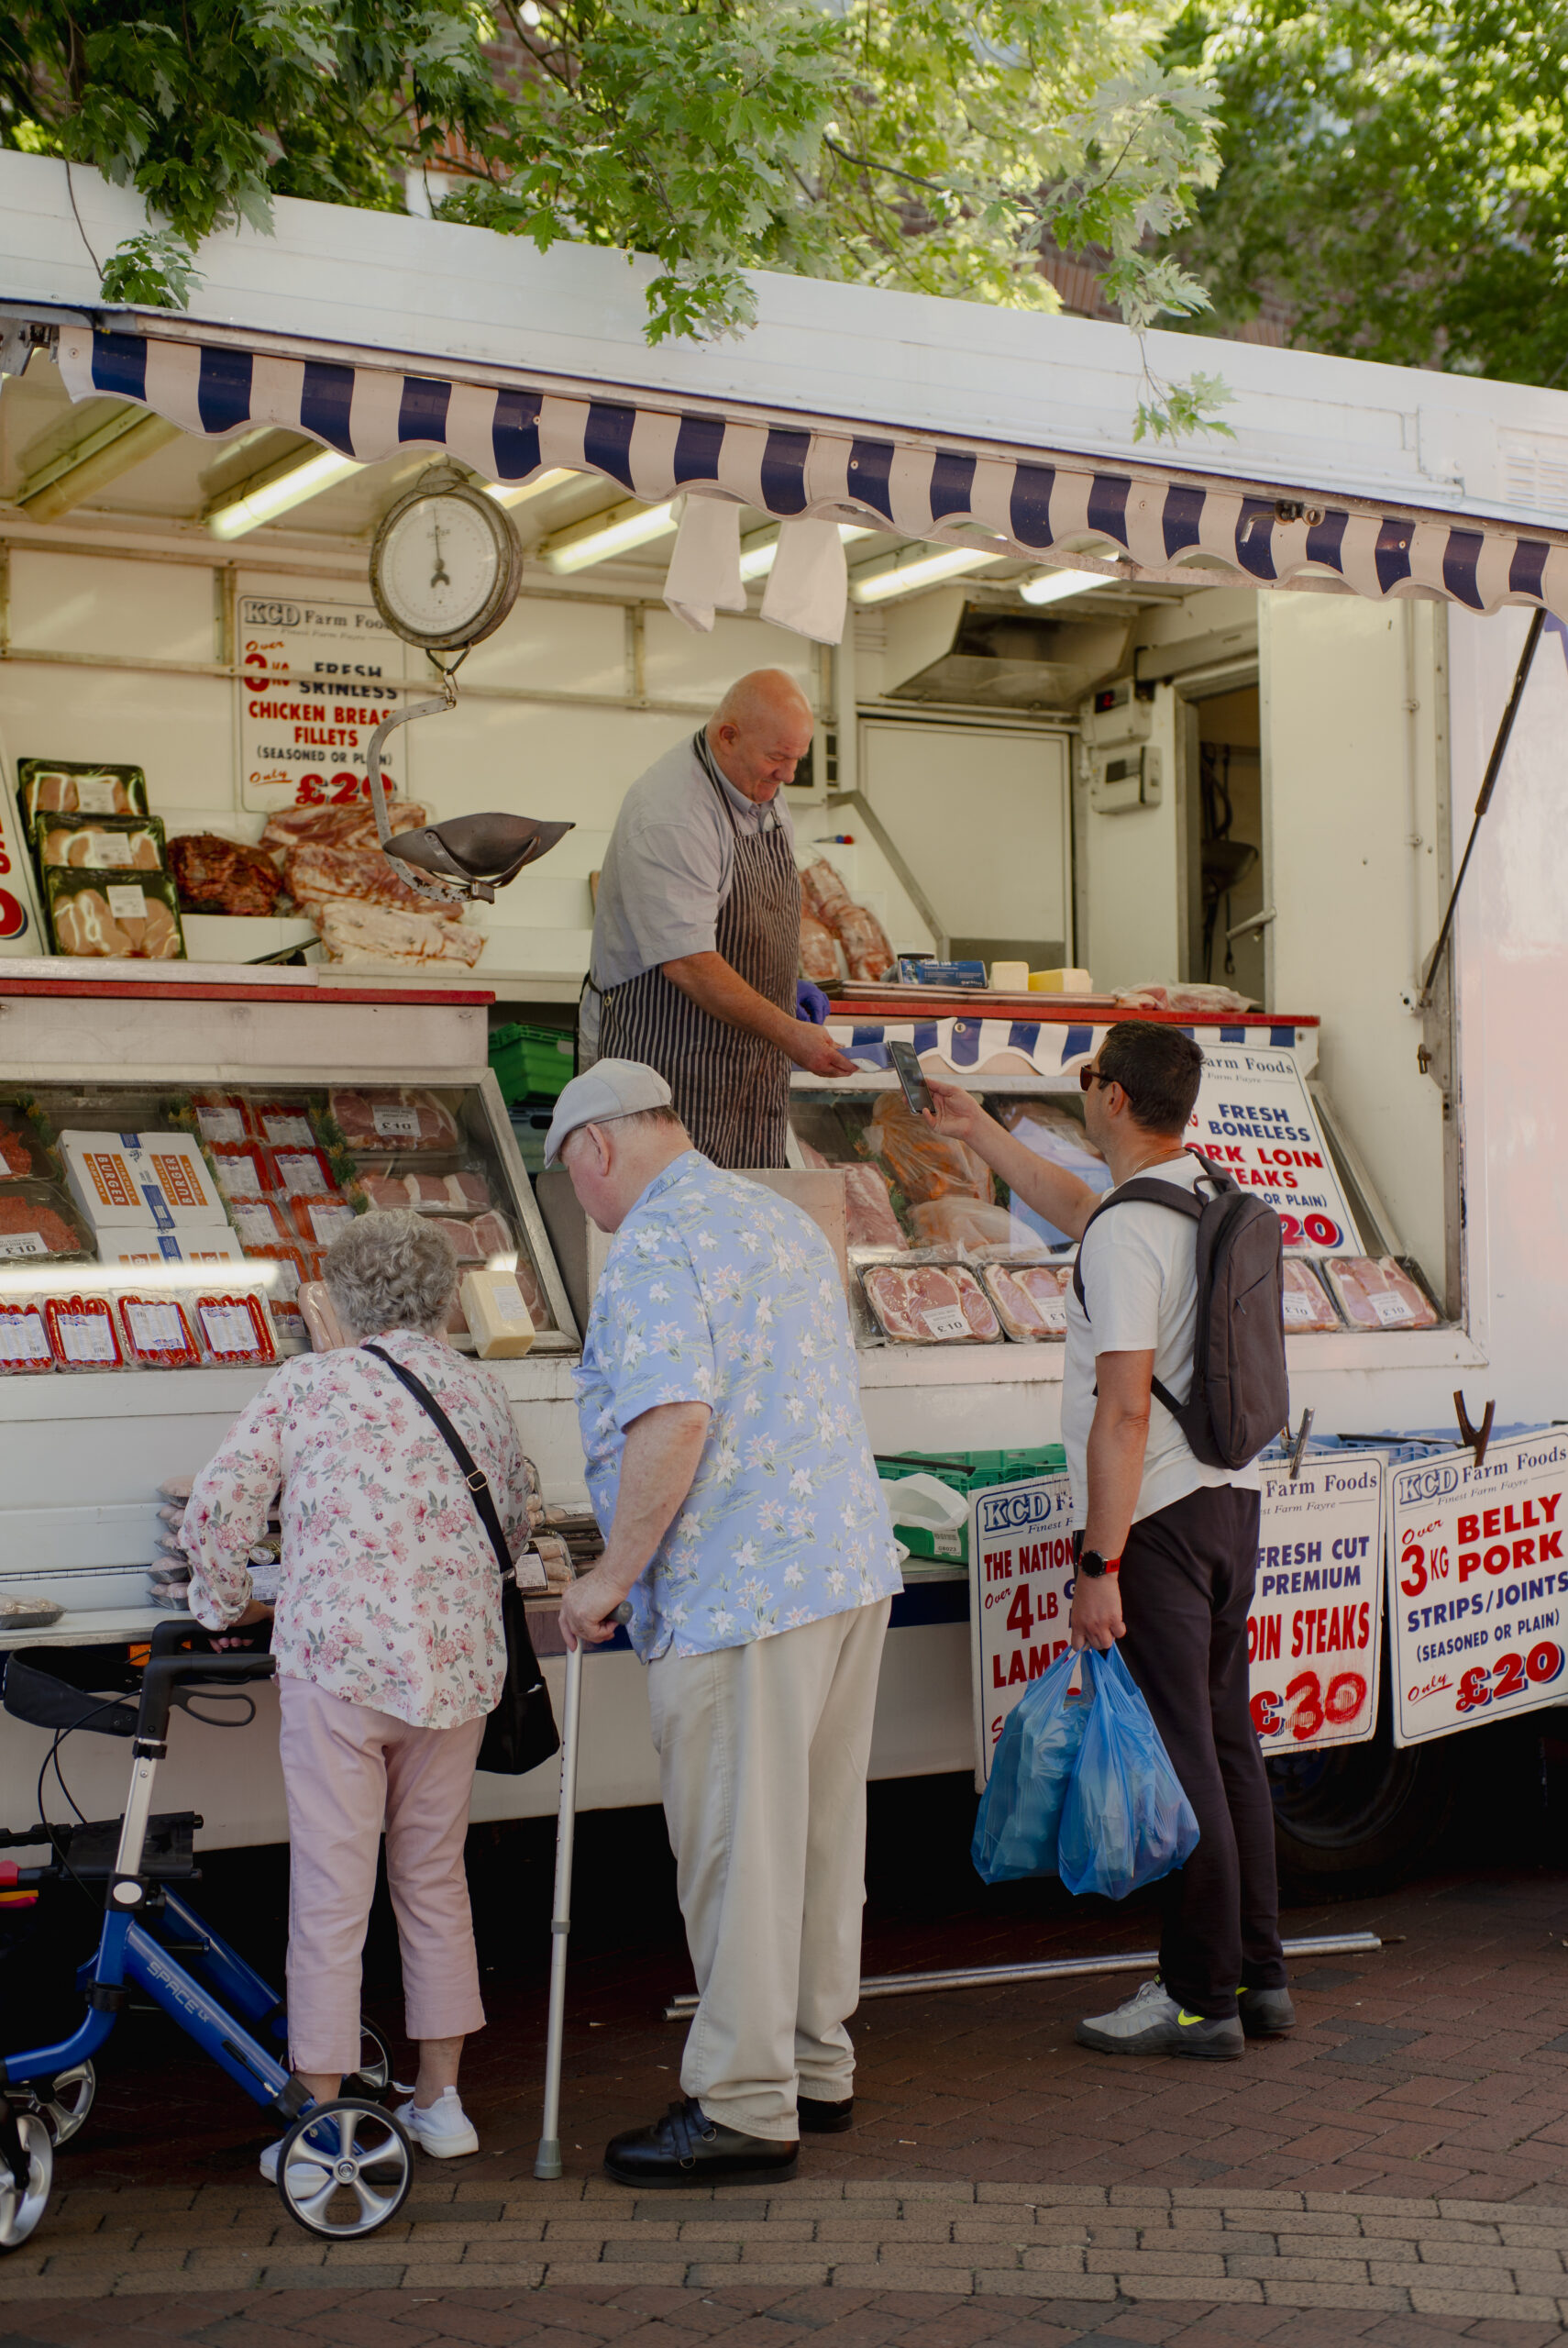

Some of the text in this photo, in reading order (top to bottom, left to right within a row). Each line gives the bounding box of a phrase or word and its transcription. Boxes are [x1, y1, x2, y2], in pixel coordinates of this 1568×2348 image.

[244, 601, 392, 629] KCD Farm Foo
[246, 640, 285, 652] Over
[315, 661, 381, 678] FRESH
[299, 681, 397, 700] SKINLESS
[248, 701, 394, 726] CHICKEN BREAS
[294, 726, 359, 748] FILLETS
[257, 745, 392, 766] (SEASONED OR PLN)
[249, 769, 287, 784] Only
[1201, 1057, 1294, 1074] arm Foods
[1207, 1072, 1232, 1081] Farm
[1235, 1074, 1262, 1084] Fayre
[1218, 1103, 1290, 1123] FRESH
[1208, 1121, 1311, 1142] BONELESS
[1185, 1142, 1324, 1168] ORK LOIN
[97, 1157, 126, 1202] BURGER
[165, 1157, 193, 1203] BURGER
[1223, 1168, 1298, 1189] TEAKS
[1264, 1192, 1282, 1204] OR
[1286, 1194, 1328, 1208] PLAIN)
[1279, 1213, 1344, 1248] 20
[1050, 1312, 1066, 1321] £1
[1285, 1306, 1309, 1315] £10
[1383, 1306, 1405, 1316] £10
[937, 1321, 963, 1333] £10
[1265, 1471, 1377, 1498] Farm Foods
[1399, 1446, 1567, 1505] KCD Farm Foods
[1437, 1479, 1529, 1506] Finest Farm Fayre
[983, 1492, 1051, 1533] KCD
[1275, 1504, 1302, 1514] Farm
[1307, 1501, 1336, 1512] Fayre
[1401, 1492, 1562, 1545] Over BELLY
[1028, 1521, 1062, 1534] Finest
[984, 1536, 1075, 1582] THE NATION
[1256, 1535, 1370, 1569] FRESH CUT
[1400, 1530, 1564, 1598] 3 KG PORK
[1262, 1565, 1361, 1597] PREMIUM
[984, 1587, 1012, 1610] Over
[1006, 1583, 1034, 1640] 4
[1037, 1591, 1059, 1622] LB
[1408, 1570, 1568, 1633] STRIPS/JOINTS
[1247, 1601, 1370, 1665] OIN STEAKS
[1417, 1608, 1560, 1663] (SEASONED OR PLAIN)
[1408, 1641, 1566, 1713] Only £20
[1250, 1671, 1367, 1741] £30
[147, 1961, 199, 2014] SPACE
